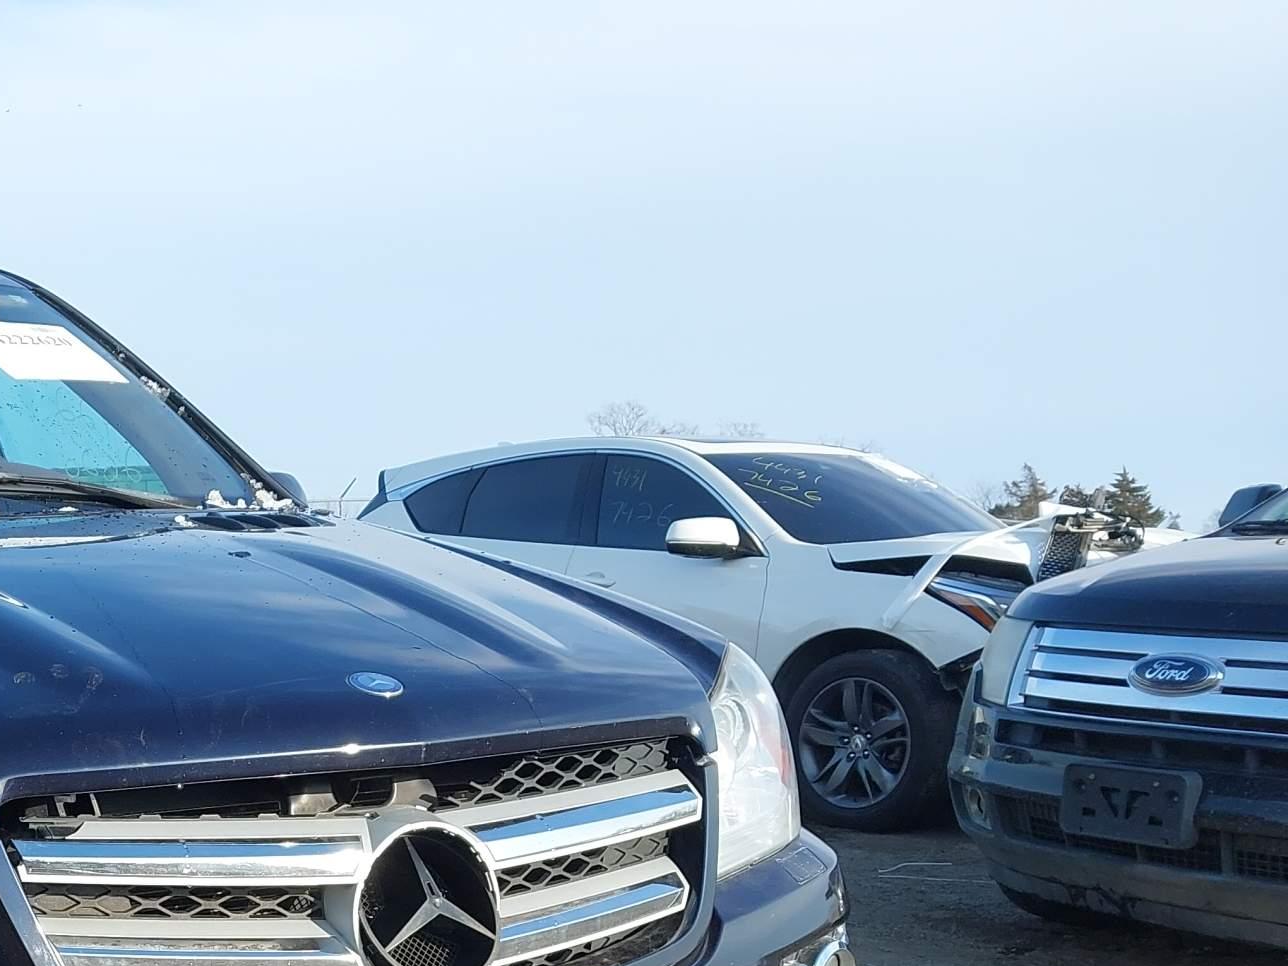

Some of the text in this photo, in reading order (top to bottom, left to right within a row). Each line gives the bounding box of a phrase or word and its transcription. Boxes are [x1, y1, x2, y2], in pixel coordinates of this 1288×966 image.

[736, 467, 822, 502] 7426
[612, 500, 674, 527] 7426
[1145, 660, 1194, 681] Ford
